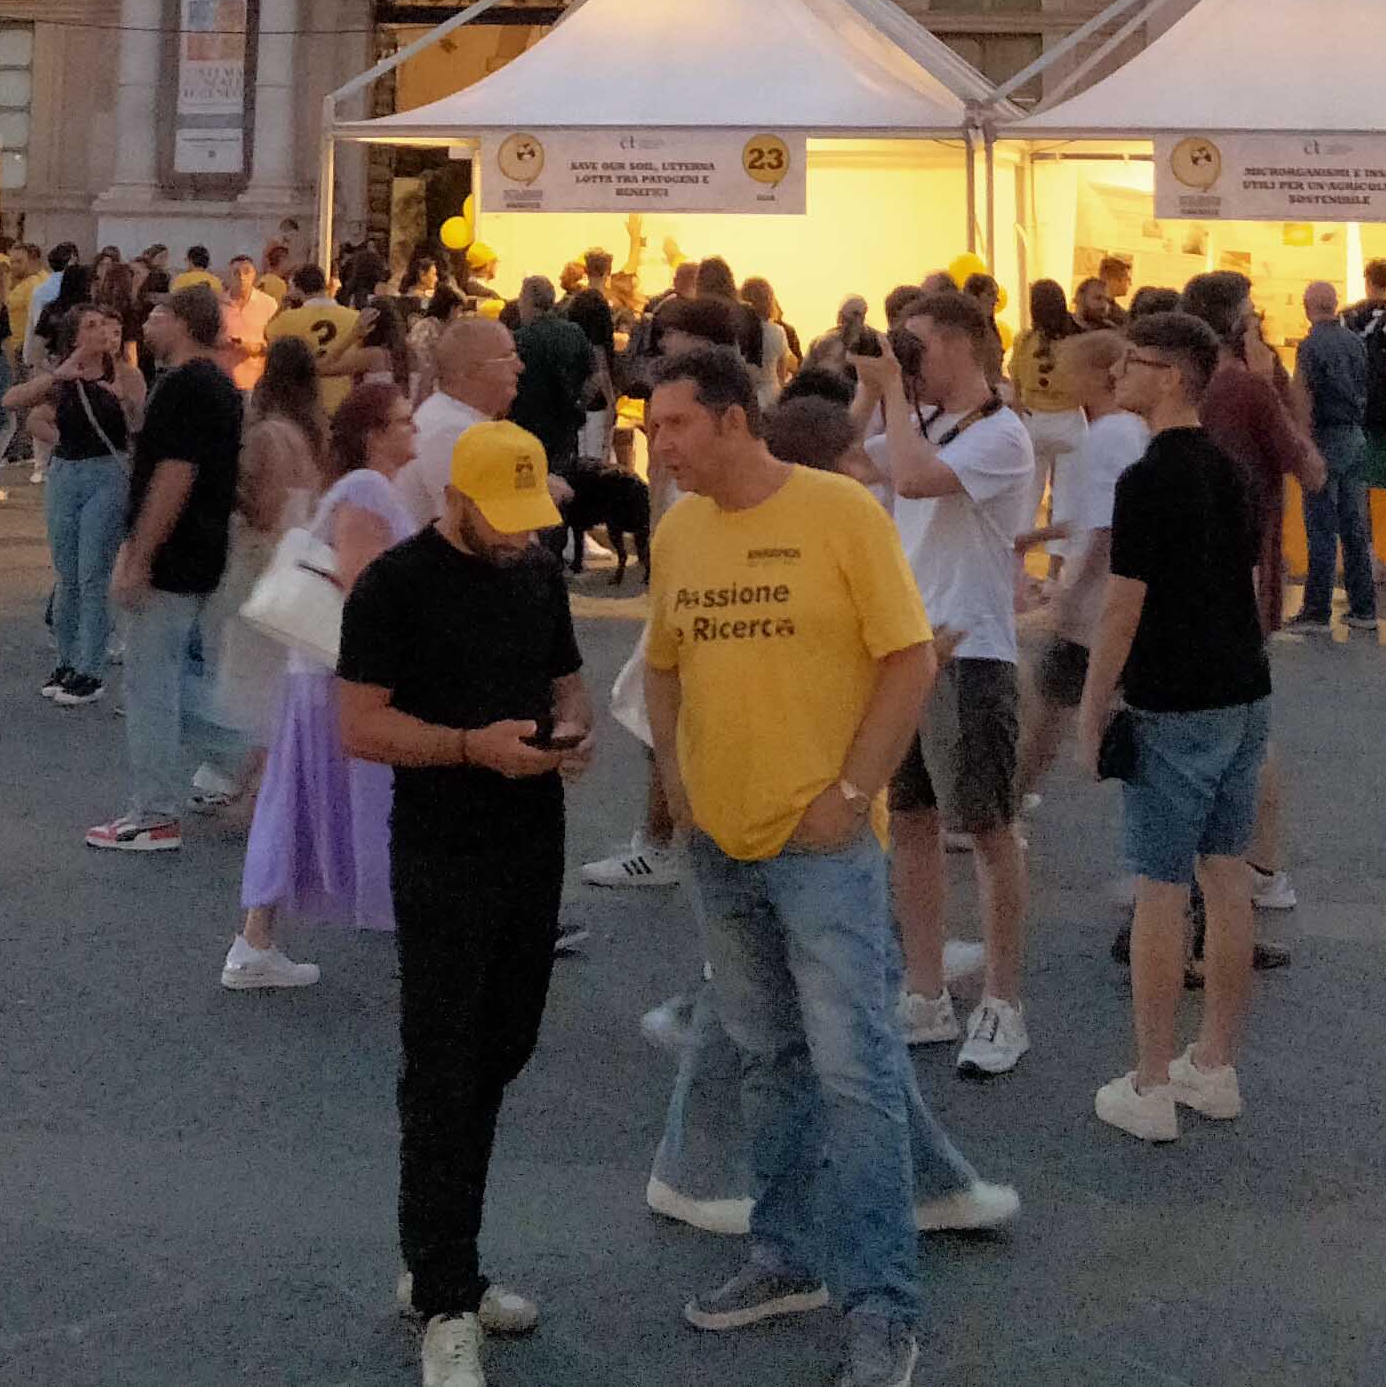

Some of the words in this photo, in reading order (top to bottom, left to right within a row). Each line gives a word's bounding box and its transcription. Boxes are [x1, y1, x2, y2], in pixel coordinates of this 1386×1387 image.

[747, 147, 784, 170] 23
[570, 162, 598, 171] SAVE
[601, 162, 625, 171] OUR
[1244, 167, 1349, 178] MICRORGANISMI
[575, 175, 612, 184] LOTTA
[615, 175, 639, 184] TRA
[641, 175, 699, 185] PATOGENI
[1242, 181, 1276, 191] UTILI
[1279, 181, 1304, 191] PER
[1288, 194, 1371, 205] SOSTENIBILE
[693, 616, 796, 643] Ricerca
